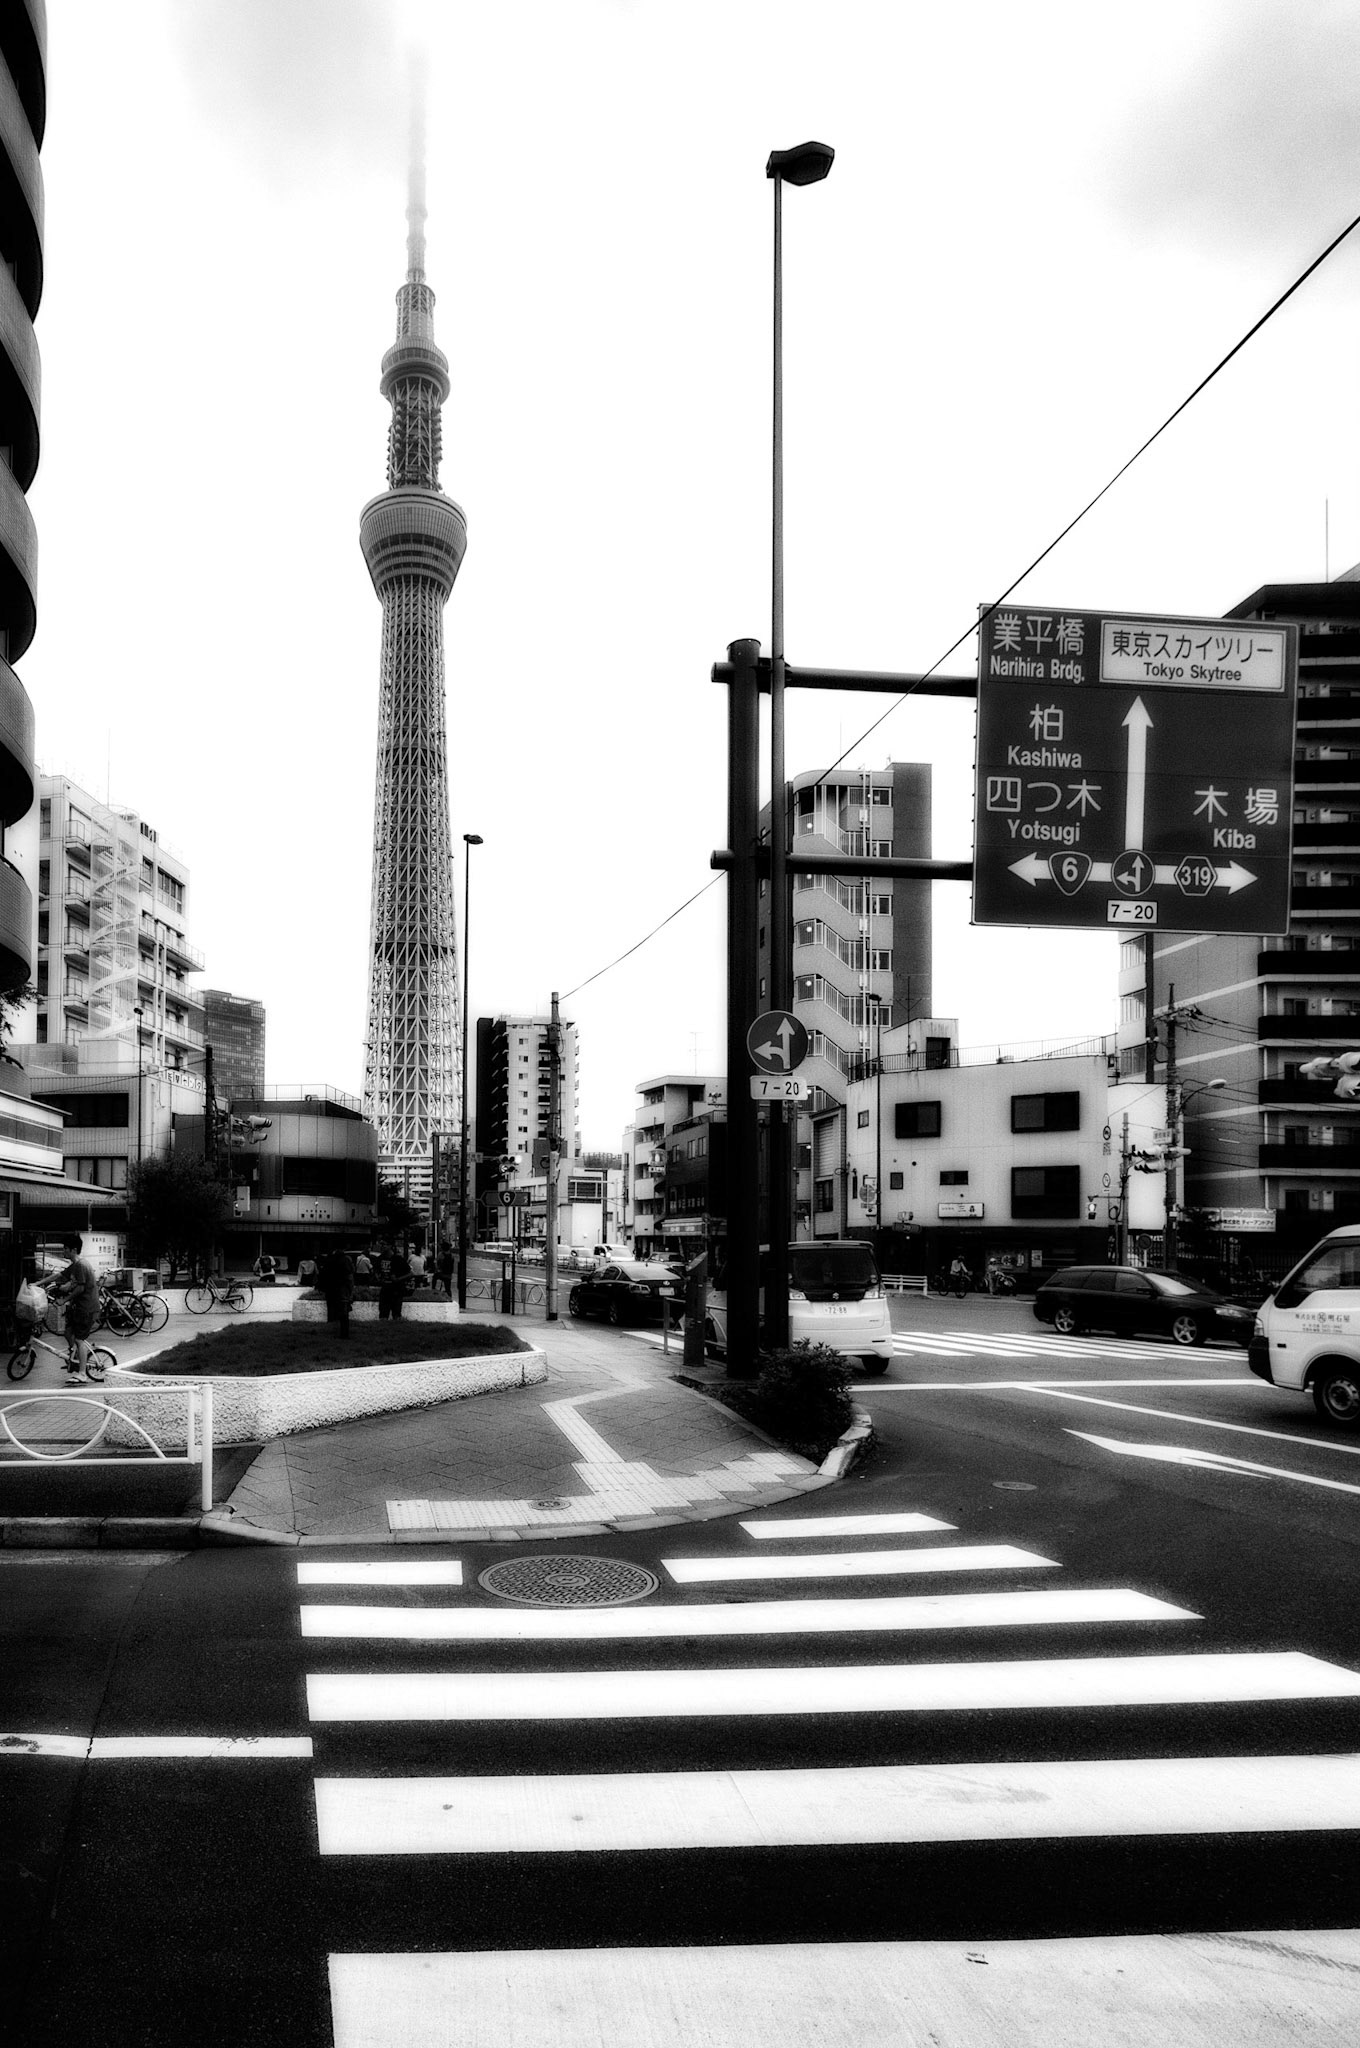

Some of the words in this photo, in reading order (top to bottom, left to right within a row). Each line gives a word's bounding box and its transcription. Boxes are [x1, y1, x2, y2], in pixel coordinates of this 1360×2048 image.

[993, 613, 1085, 656] 業平橋
[1111, 630, 1273, 663] 東京スカイツリー
[990, 655, 1044, 678] Narihira
[1050, 659, 1085, 683] Brdg.
[1143, 662, 1184, 680] Tokyo
[1190, 665, 1242, 682] Skytree
[1029, 703, 1063, 741] 柏
[1007, 745, 1082, 768] Kashiwa
[986, 776, 1102, 817] 四つ木
[1193, 785, 1279, 826] 木場
[1007, 818, 1081, 846] Yotsugi
[1213, 828, 1257, 849] Kiba
[1061, 857, 1078, 882] 6
[1180, 865, 1210, 884] 319
[1111, 903, 1154, 920] 7-20
[760, 1081, 799, 1096] 7-20
[503, 1192, 511, 1204] 6
